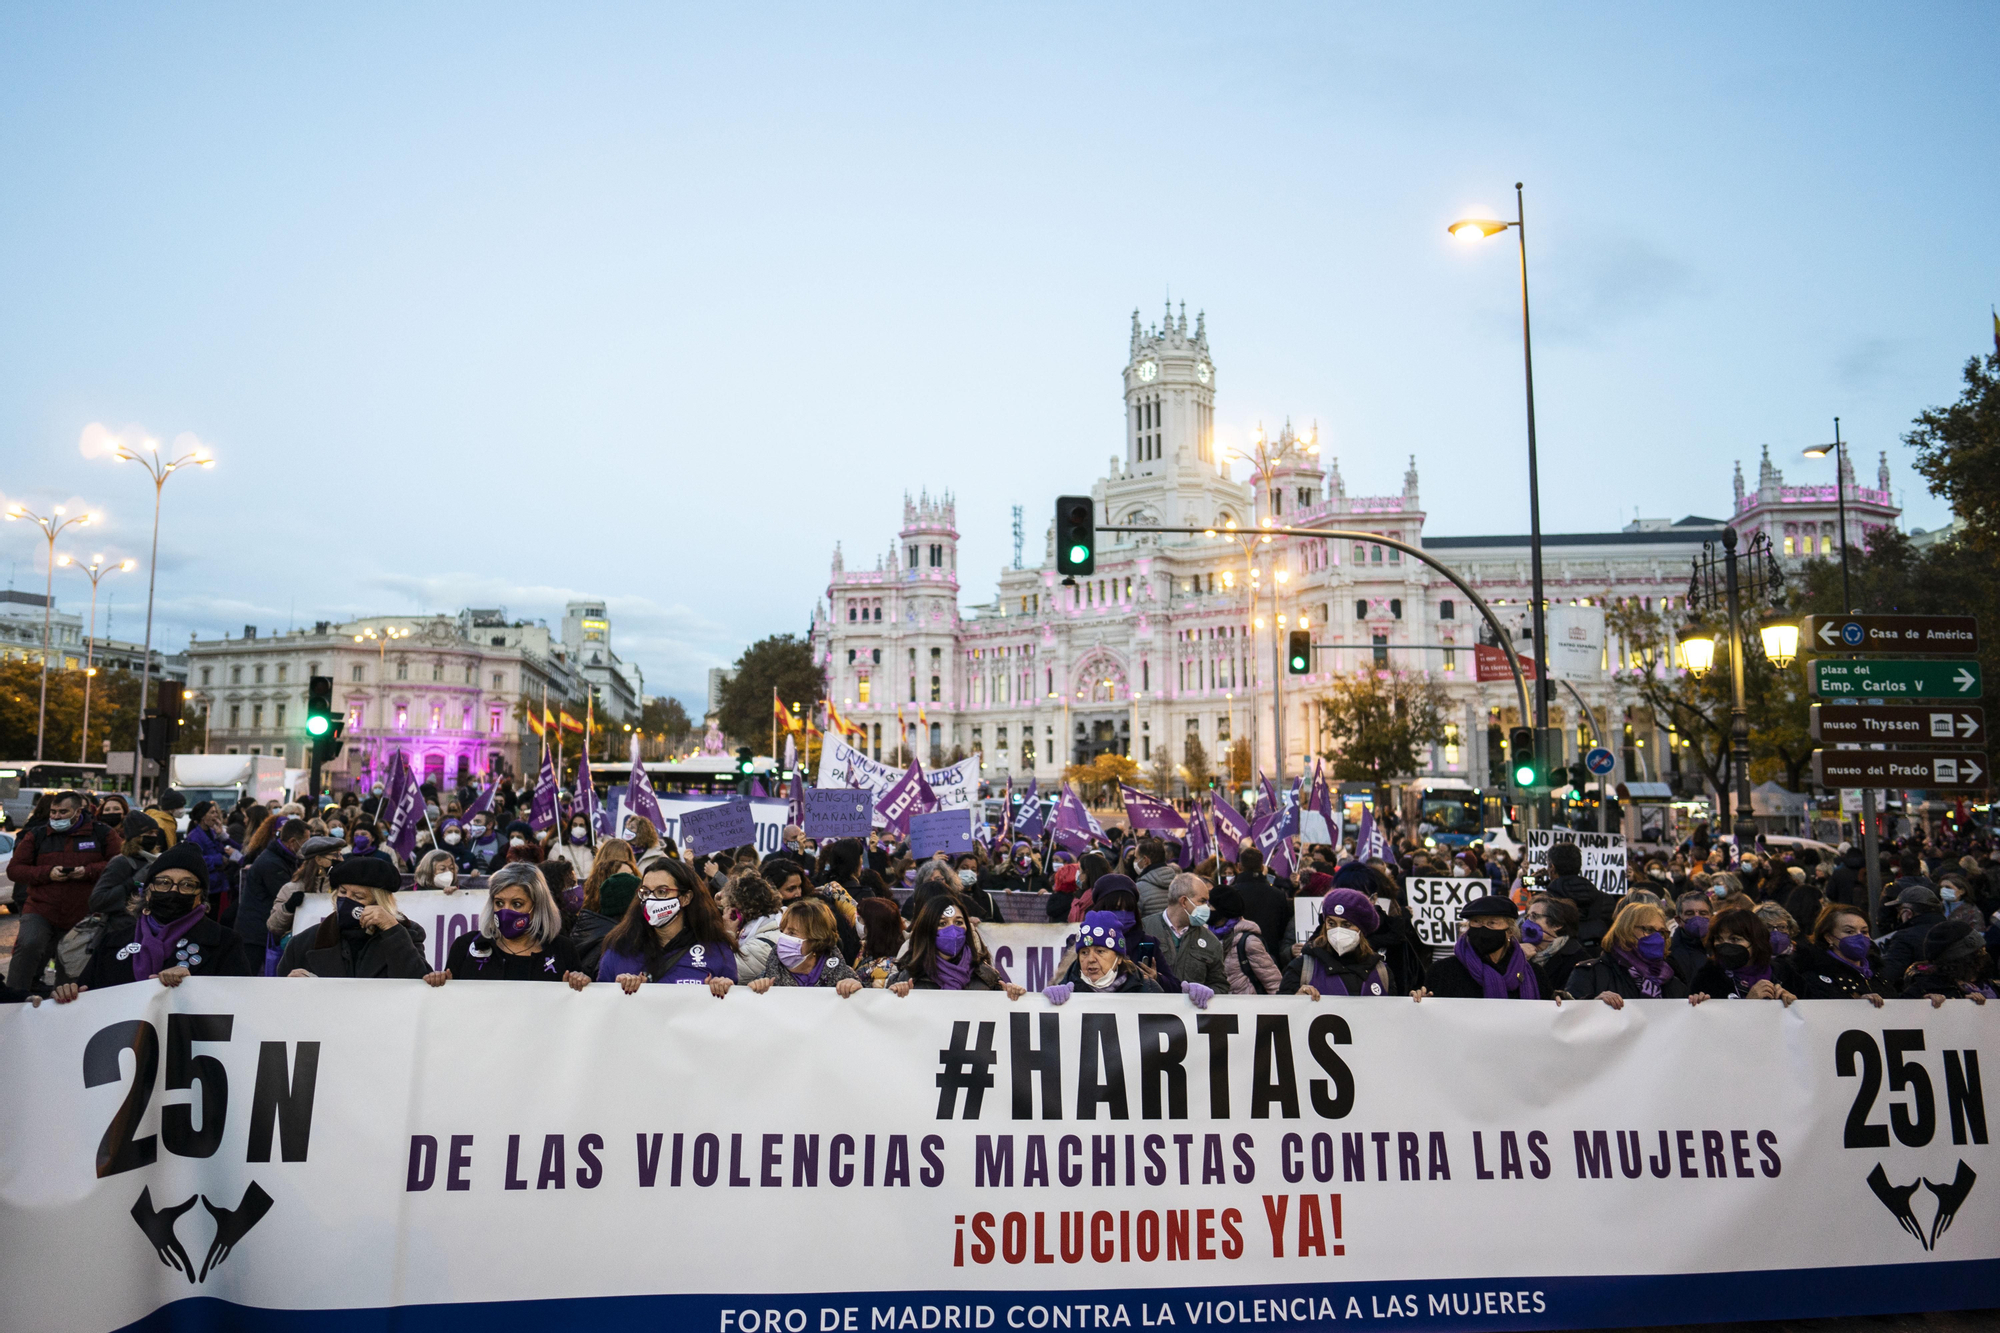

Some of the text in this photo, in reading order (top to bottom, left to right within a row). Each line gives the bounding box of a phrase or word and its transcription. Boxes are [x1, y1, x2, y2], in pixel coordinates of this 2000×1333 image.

[1869, 628, 1974, 640] Casa de América
[1820, 666, 1870, 676] plaza del
[1821, 680, 1924, 693] Emp. Carlos V
[1822, 718, 1920, 732] museo Thyssen
[1827, 763, 1929, 776] museo del Prado
[807, 792, 871, 805] VENGO HOY
[681, 811, 717, 828] HARTA
[719, 807, 731, 817] DE
[811, 811, 867, 822] MAÑANA
[693, 816, 746, 837] LA DERECHA
[702, 826, 746, 843] ME TOQUE
[1528, 831, 1550, 848] NO
[1579, 834, 1609, 849] NADA
[1612, 836, 1624, 848] DE
[1586, 852, 1600, 867] EN
[1601, 853, 1625, 867] UNA
[1413, 878, 1488, 905] SEXO
[1421, 906, 1446, 921] NO
[936, 1012, 1355, 1121] #HARTAS
[405, 1130, 1782, 1192] DE LAS VIOLENCIAS MACHISTAS CONTRA LAS MUJERES
[954, 1193, 1342, 1267] ¡SOLUCIONES YA!
[720, 1290, 1546, 1333] FORO DE MADRID CONTRA LA VIOLENCIA A LAS MUJERES
